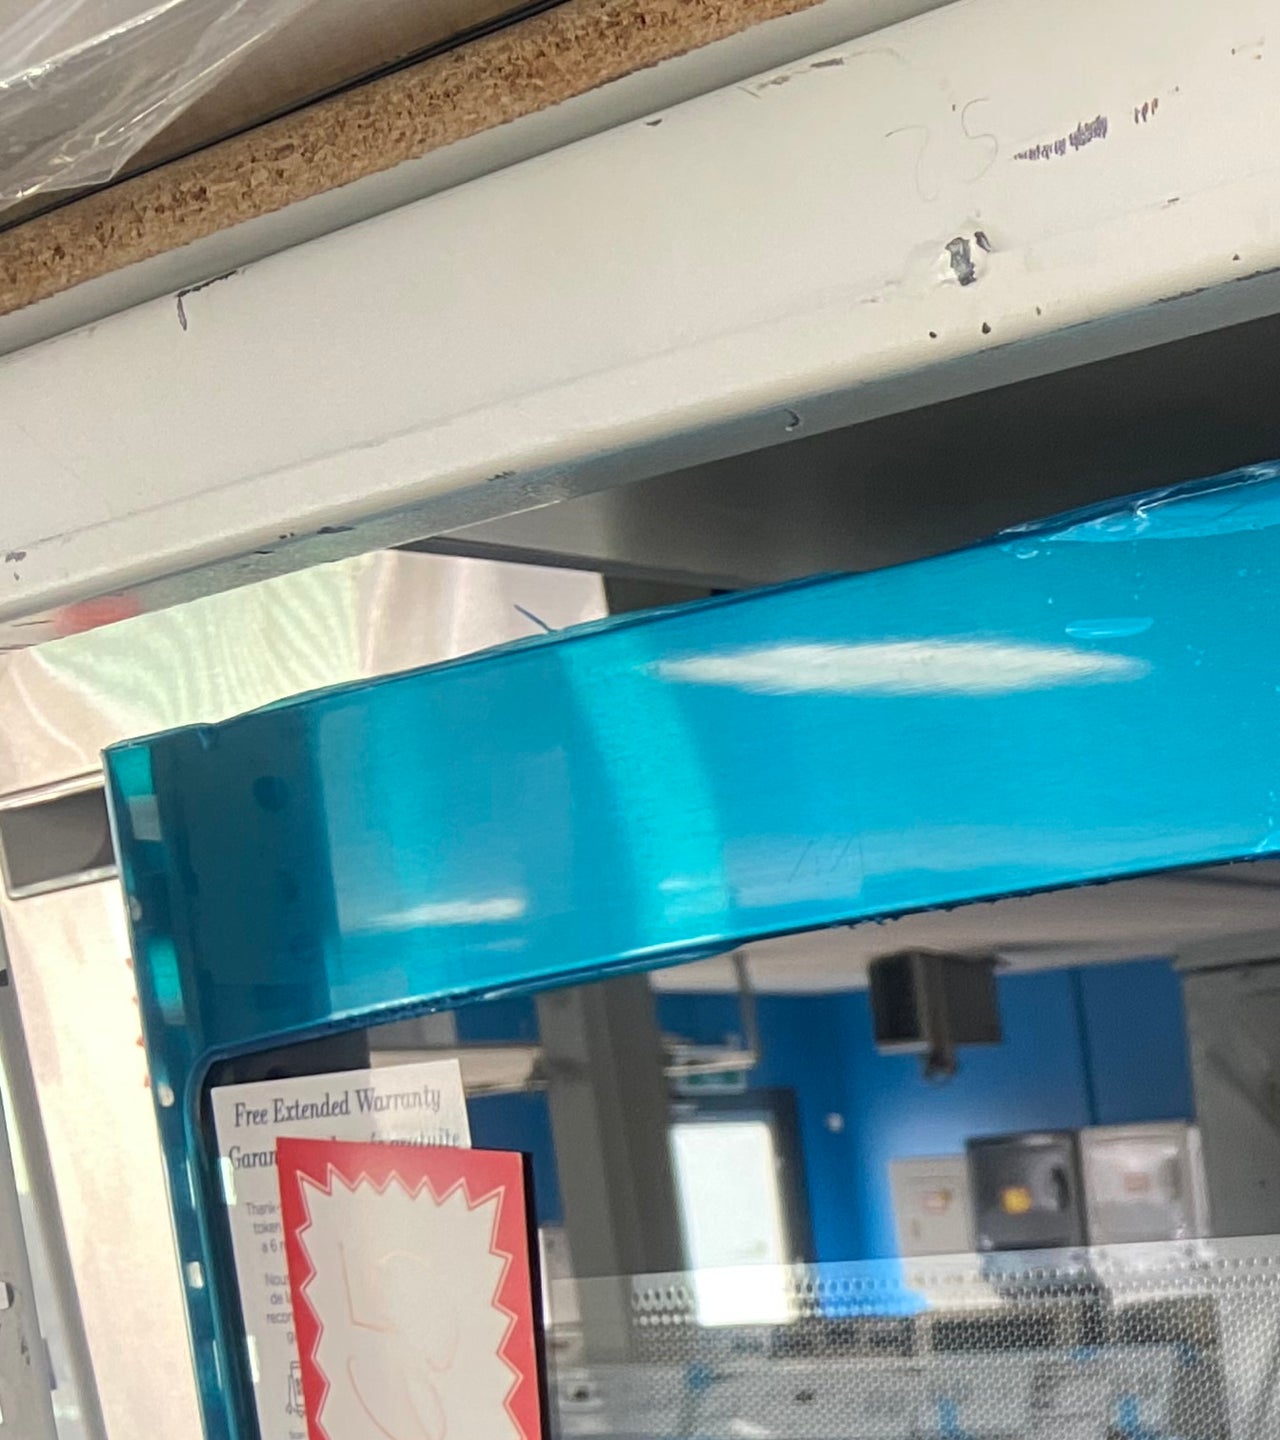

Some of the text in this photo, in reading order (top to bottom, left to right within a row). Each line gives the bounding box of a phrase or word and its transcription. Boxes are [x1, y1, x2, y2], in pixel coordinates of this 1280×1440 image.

[234, 1084, 442, 1128] Free Extended Warranty
[228, 1145, 279, 1170] Garan
